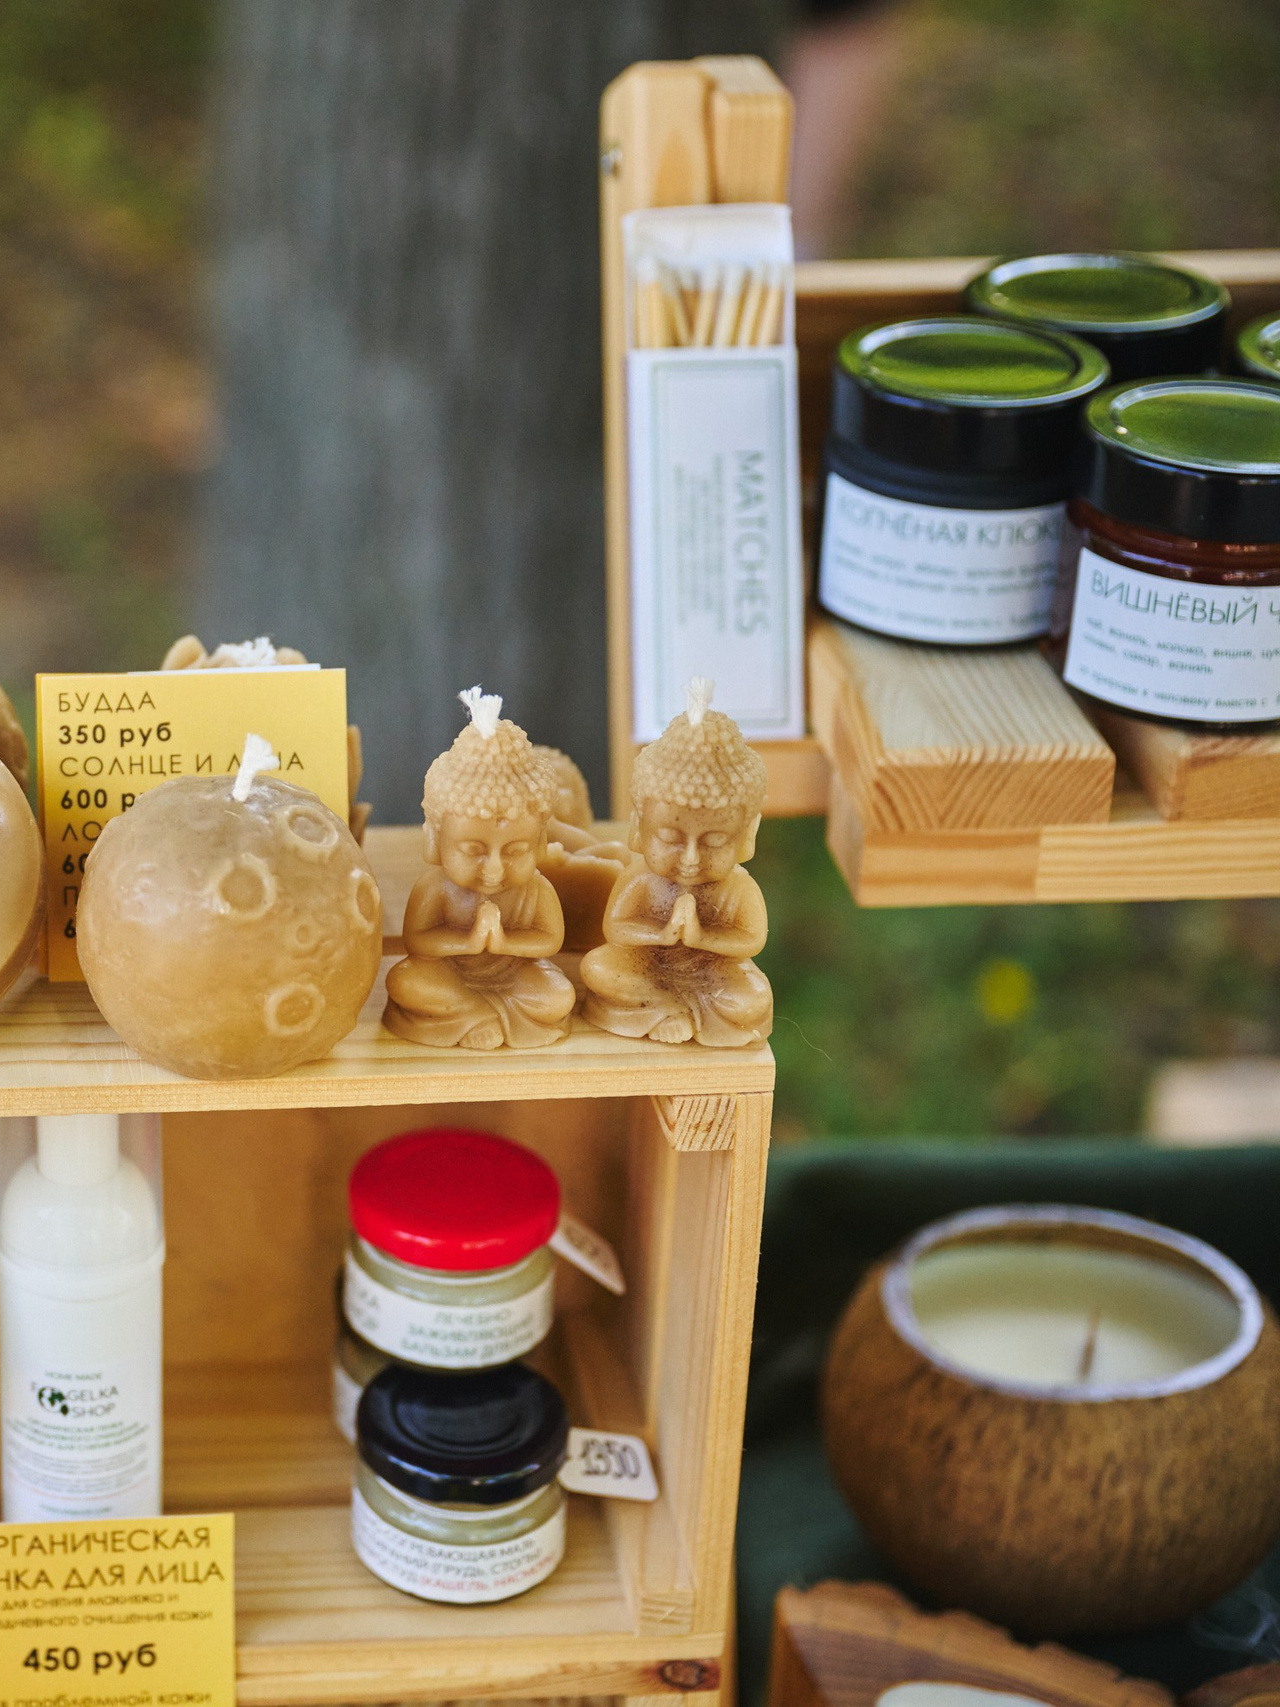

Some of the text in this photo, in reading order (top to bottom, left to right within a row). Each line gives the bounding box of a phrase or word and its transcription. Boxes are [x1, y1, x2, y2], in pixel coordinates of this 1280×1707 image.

[976, 513, 1060, 549] КЛЮК
[734, 450, 768, 637] MATCHES
[1090, 568, 1260, 626] ВИШНЁВЫЙ
[58, 690, 156, 713] БУДДА
[58, 722, 172, 747] 350 руб
[59, 751, 305, 777] СОЛНЦЕ И ЛА
[60, 789, 107, 810] 600
[62, 821, 102, 842] ЛО
[62, 853, 85, 875] 60
[71, 1402, 116, 1418] SHOP
[63, 1564, 126, 1591] ДЛЯ
[136, 1561, 225, 1586] ЛИЦА
[0, 1593, 179, 1612] для снятия макияжа и
[82, 1612, 166, 1627] очищения
[170, 1610, 214, 1623] кожи
[23, 1643, 157, 1675] 450 руб
